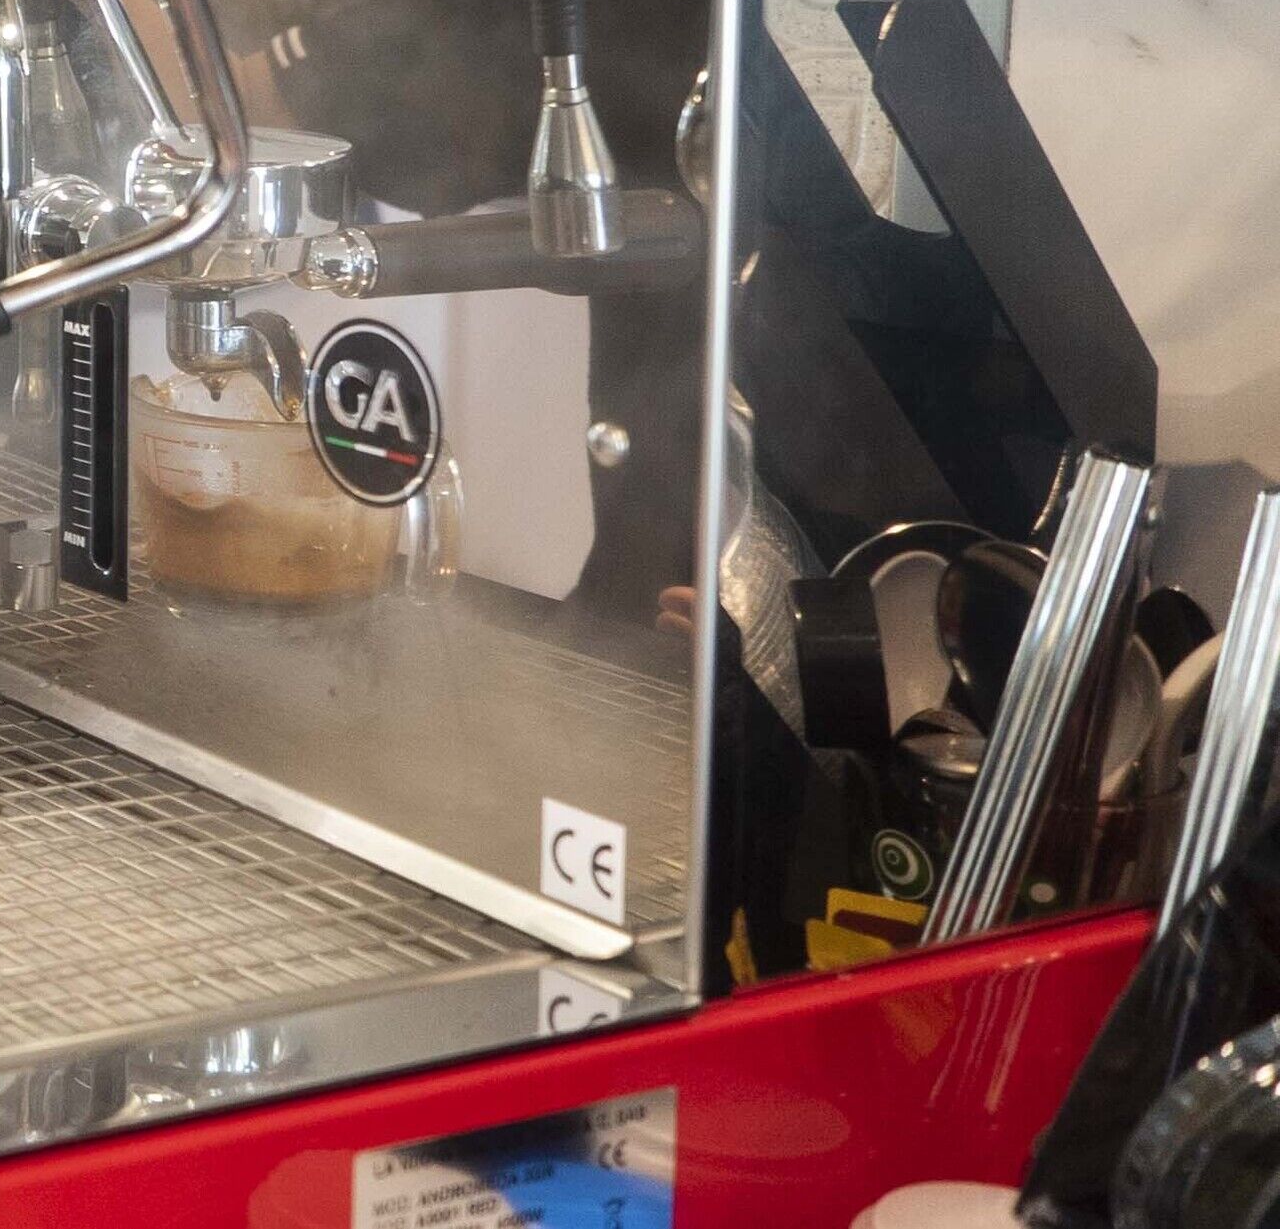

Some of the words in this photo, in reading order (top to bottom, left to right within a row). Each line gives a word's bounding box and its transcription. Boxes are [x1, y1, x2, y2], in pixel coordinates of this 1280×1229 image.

[63, 320, 90, 338] MAX
[325, 359, 418, 444] GA
[63, 530, 87, 549] MIN
[552, 828, 613, 900] CE
